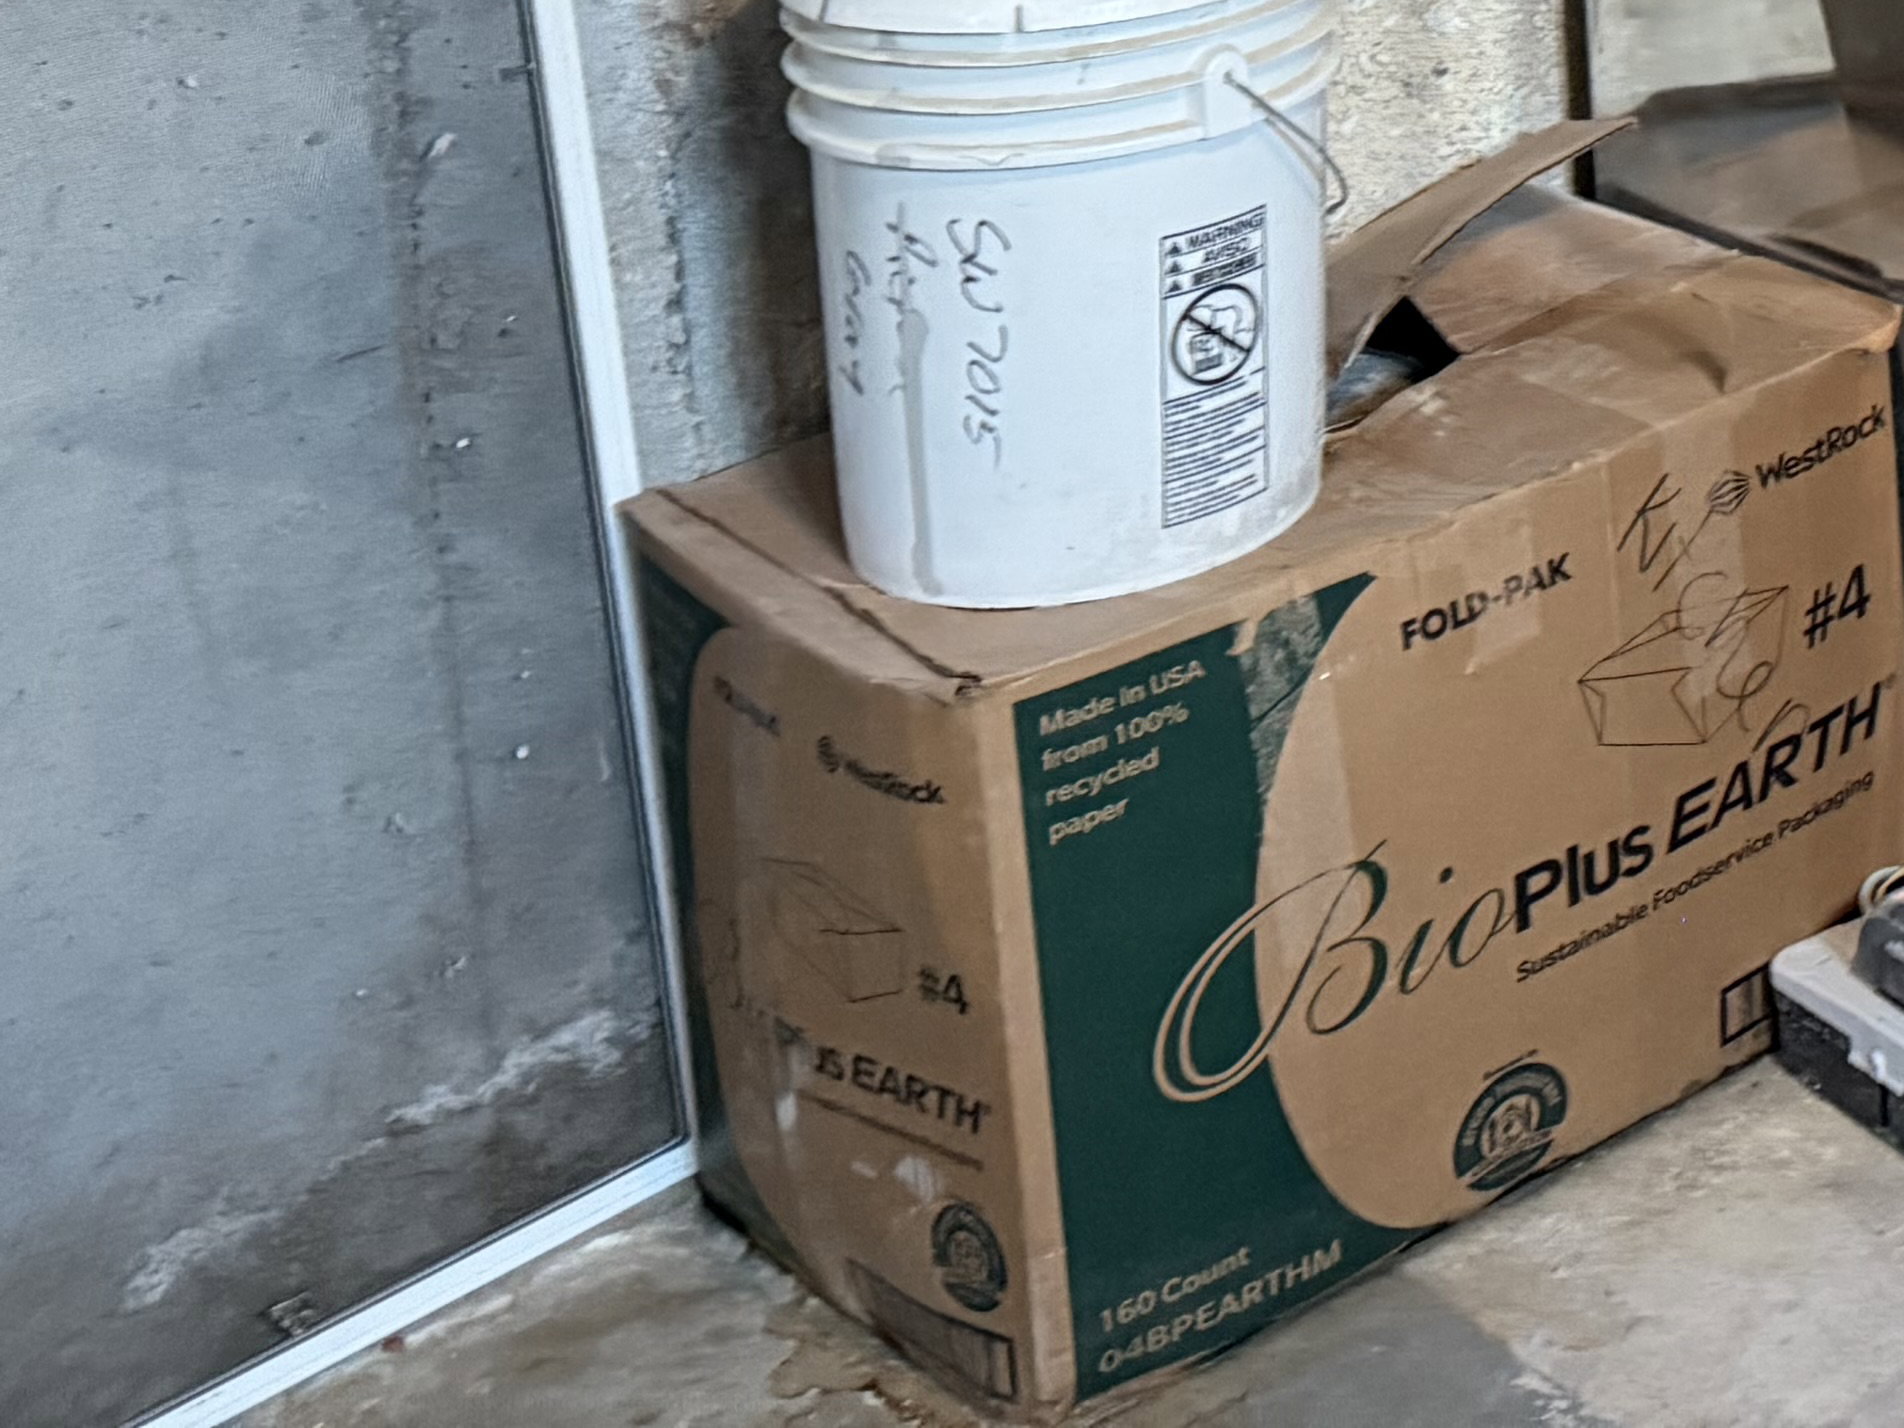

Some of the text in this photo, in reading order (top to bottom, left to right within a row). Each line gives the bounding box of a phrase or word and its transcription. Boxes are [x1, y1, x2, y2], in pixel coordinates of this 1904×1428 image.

[1755, 403, 1886, 491] WestRock
[1401, 551, 1573, 652] FOLD-PAK
[1804, 563, 1872, 650] #4
[1039, 696, 1116, 737] Made
[1149, 659, 1207, 696] USA
[1041, 701, 1191, 772] from 100%
[1045, 746, 1160, 807] recycled
[1666, 680, 1884, 856] EARTH
[1049, 797, 1130, 847] paper
[1515, 770, 1875, 984] Sustainable Foodservice Packaging
[850, 1052, 984, 1136] EARTH
[1098, 1238, 1343, 1374] 04BPEARTHM
[1099, 1246, 1252, 1333] 160 Count
